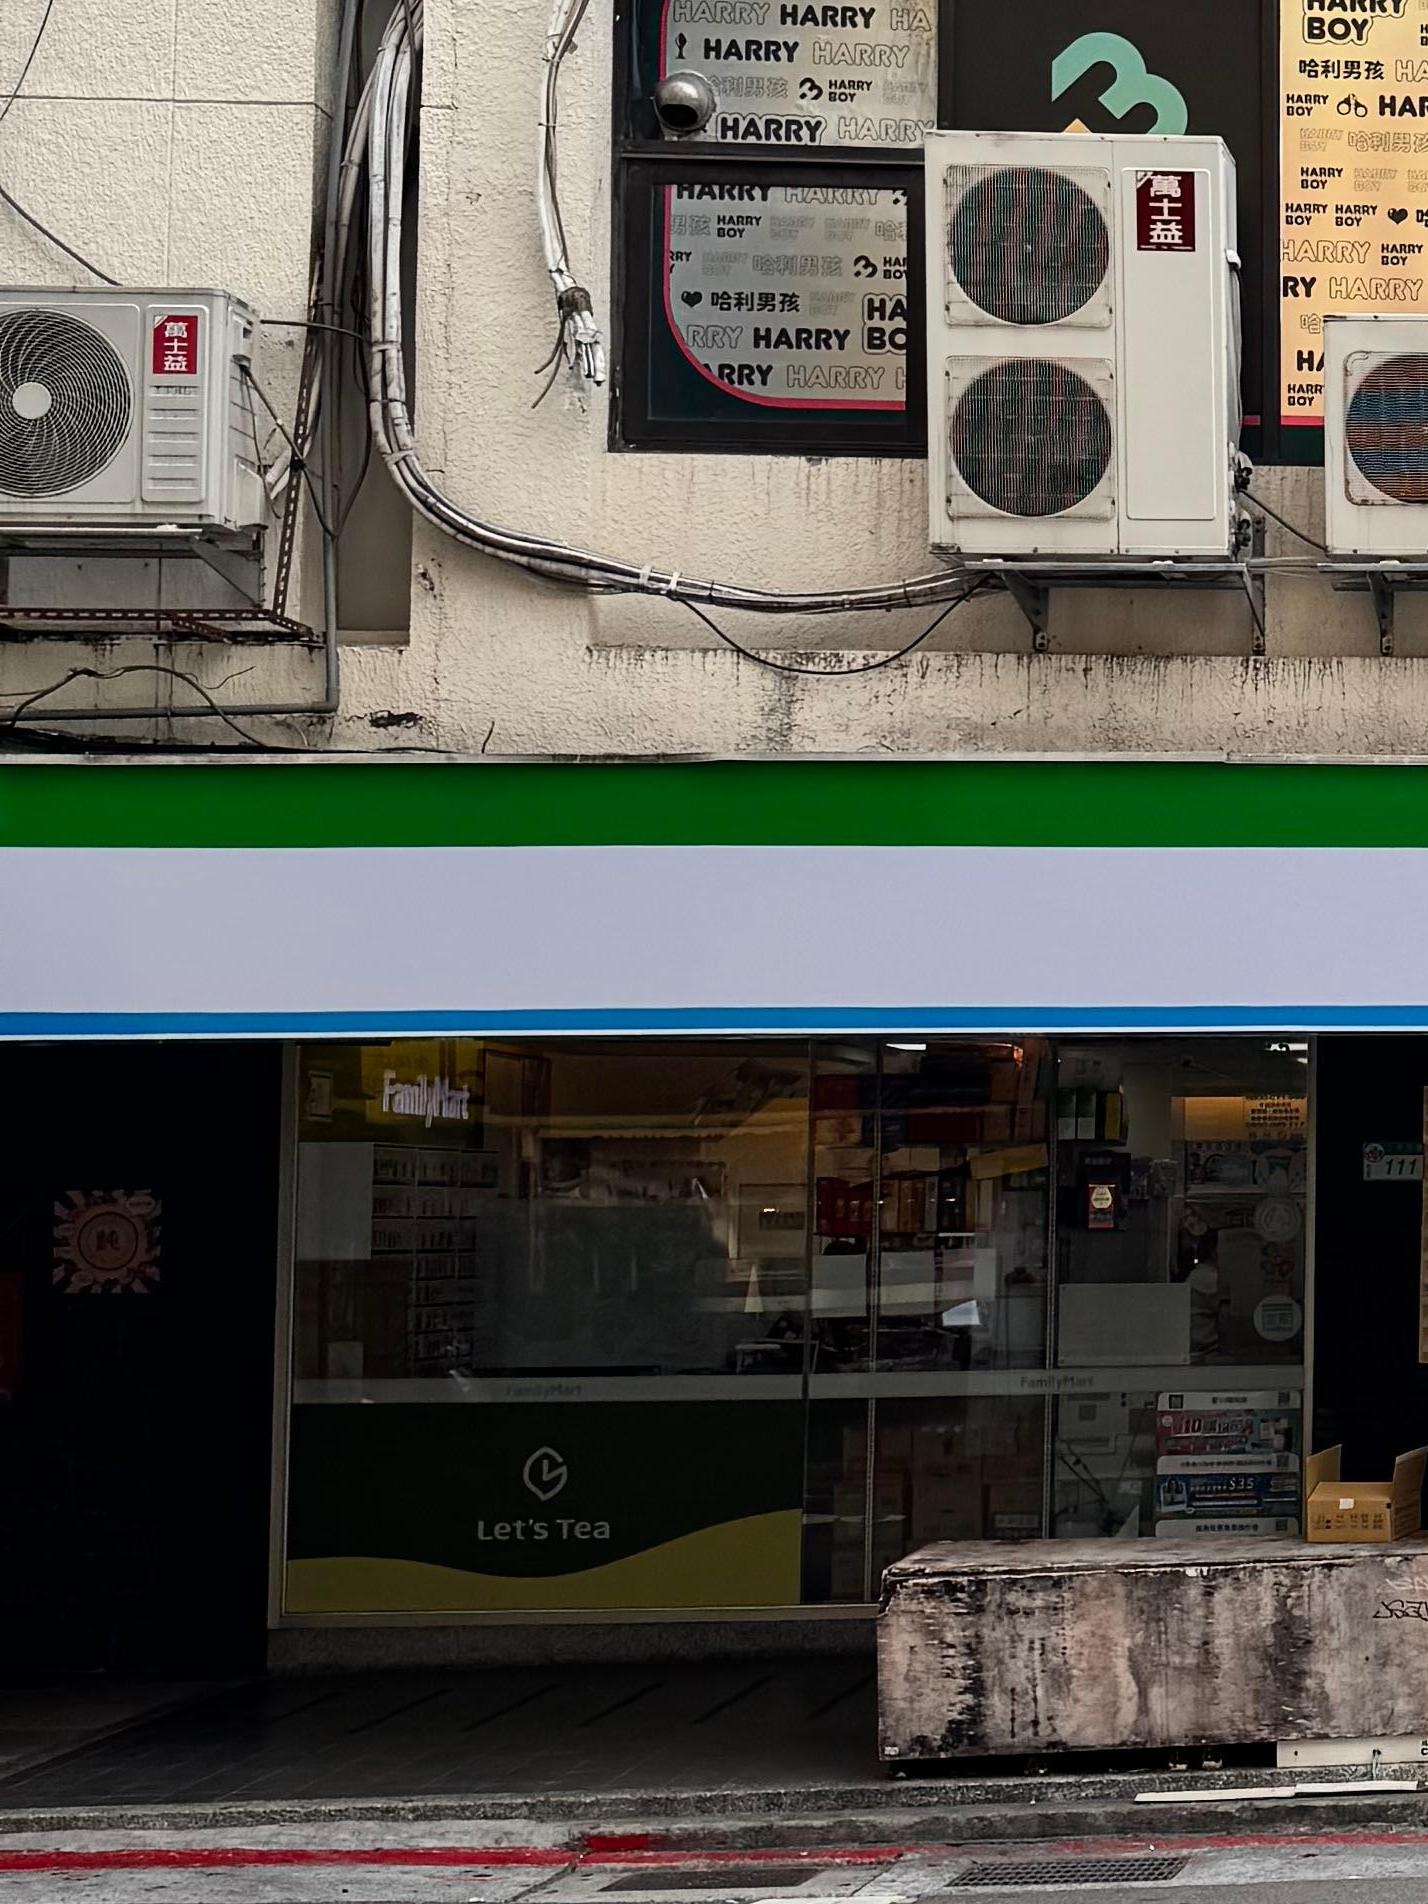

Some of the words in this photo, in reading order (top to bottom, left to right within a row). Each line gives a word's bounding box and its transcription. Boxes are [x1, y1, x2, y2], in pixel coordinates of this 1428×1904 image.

[673, 0, 770, 25] HARRY
[780, 4, 876, 28] HARRY
[1307, 17, 1369, 41] BOY
[704, 38, 799, 62] HARRY
[812, 41, 909, 68] HARRY
[1299, 59, 1384, 80] 哈利男孩
[828, 80, 872, 91] HARRY
[828, 92, 856, 103] BOY
[1286, 94, 1329, 105] HARRY
[1286, 106, 1313, 116] BOY
[720, 116, 824, 142] HARRY
[838, 117, 934, 142] HARRY
[1301, 167, 1343, 178] HARRY
[1301, 179, 1327, 189] BOY
[676, 184, 771, 202] HARRY
[784, 187, 879, 205] HARRY
[1149, 173, 1184, 245] 萬士益
[1285, 203, 1328, 214] HARRY
[1335, 204, 1378, 215] HARRY
[717, 215, 762, 226] HARRY
[1285, 215, 1312, 226] BOY
[1335, 216, 1362, 227] BOY
[717, 228, 745, 238] BOY
[1281, 240, 1371, 264] HARRY
[1381, 244, 1423, 255] HARRY
[1381, 255, 1408, 266] BOY
[1329, 277, 1424, 301] HARRY
[711, 291, 800, 313] 哈利男孩
[163, 321, 188, 372] 萬士益
[754, 328, 850, 350] HARRY
[786, 365, 885, 389] HARRY
[477, 1518, 549, 1540] Let's
[555, 1518, 610, 1540] Tea
